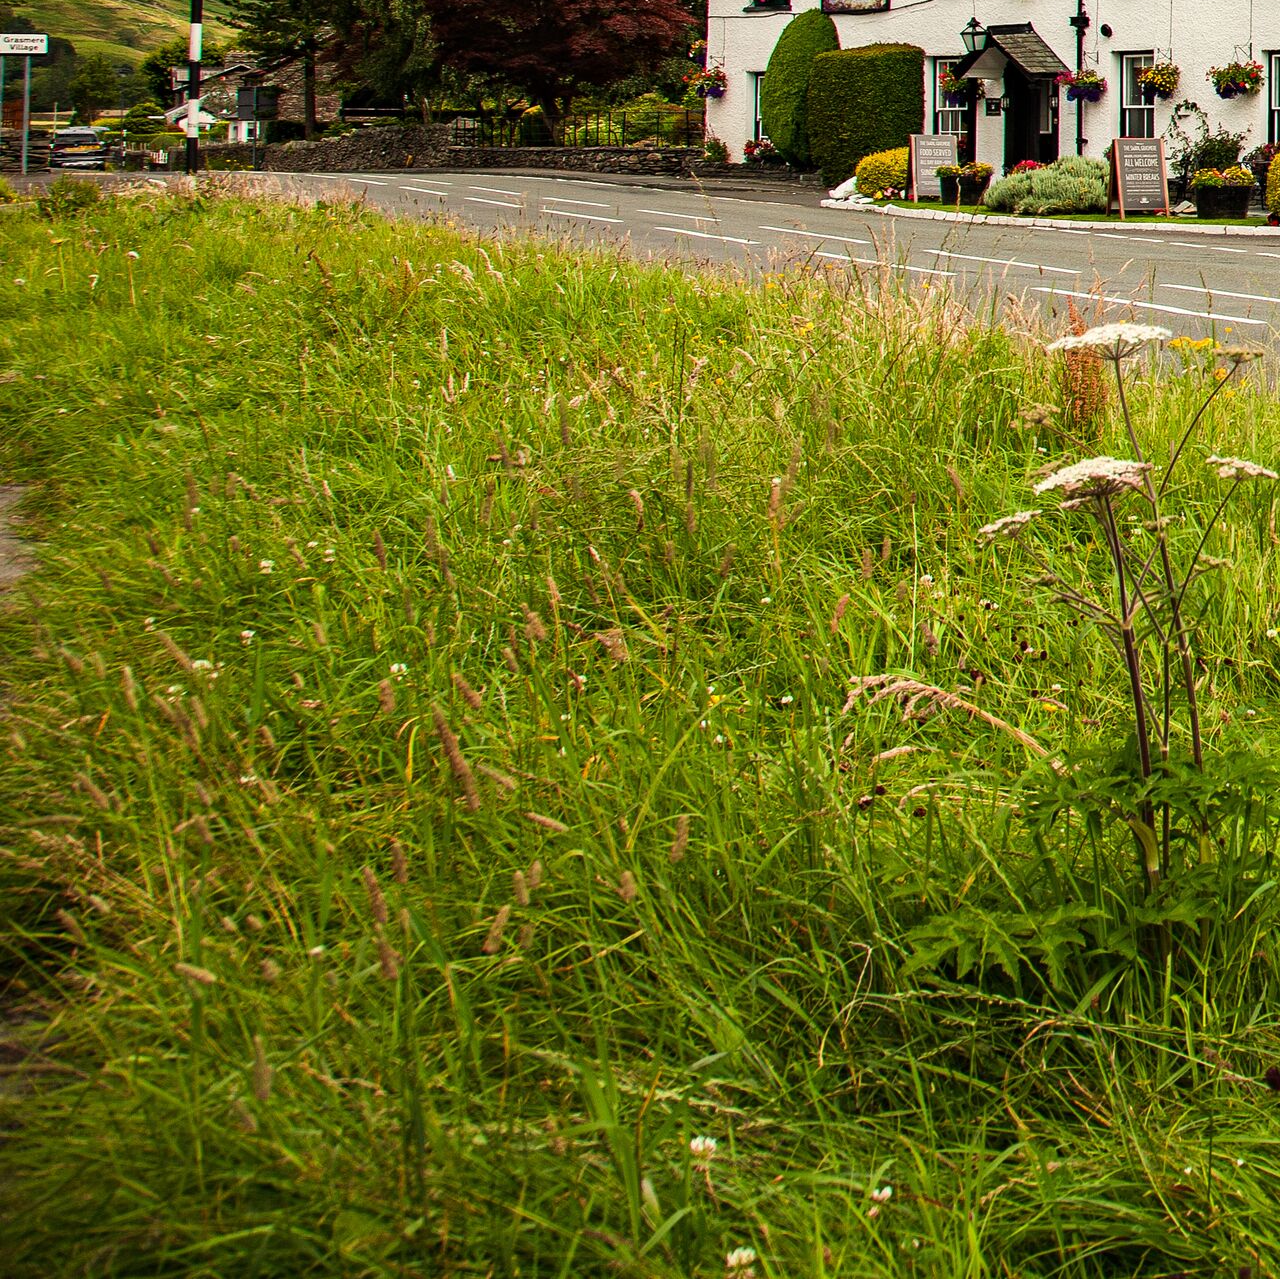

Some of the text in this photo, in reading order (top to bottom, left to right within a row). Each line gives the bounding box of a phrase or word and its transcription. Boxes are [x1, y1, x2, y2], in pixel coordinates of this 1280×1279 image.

[920, 149, 952, 157] FOOD SERVED
[1125, 158, 1159, 167] ALL WELCOME
